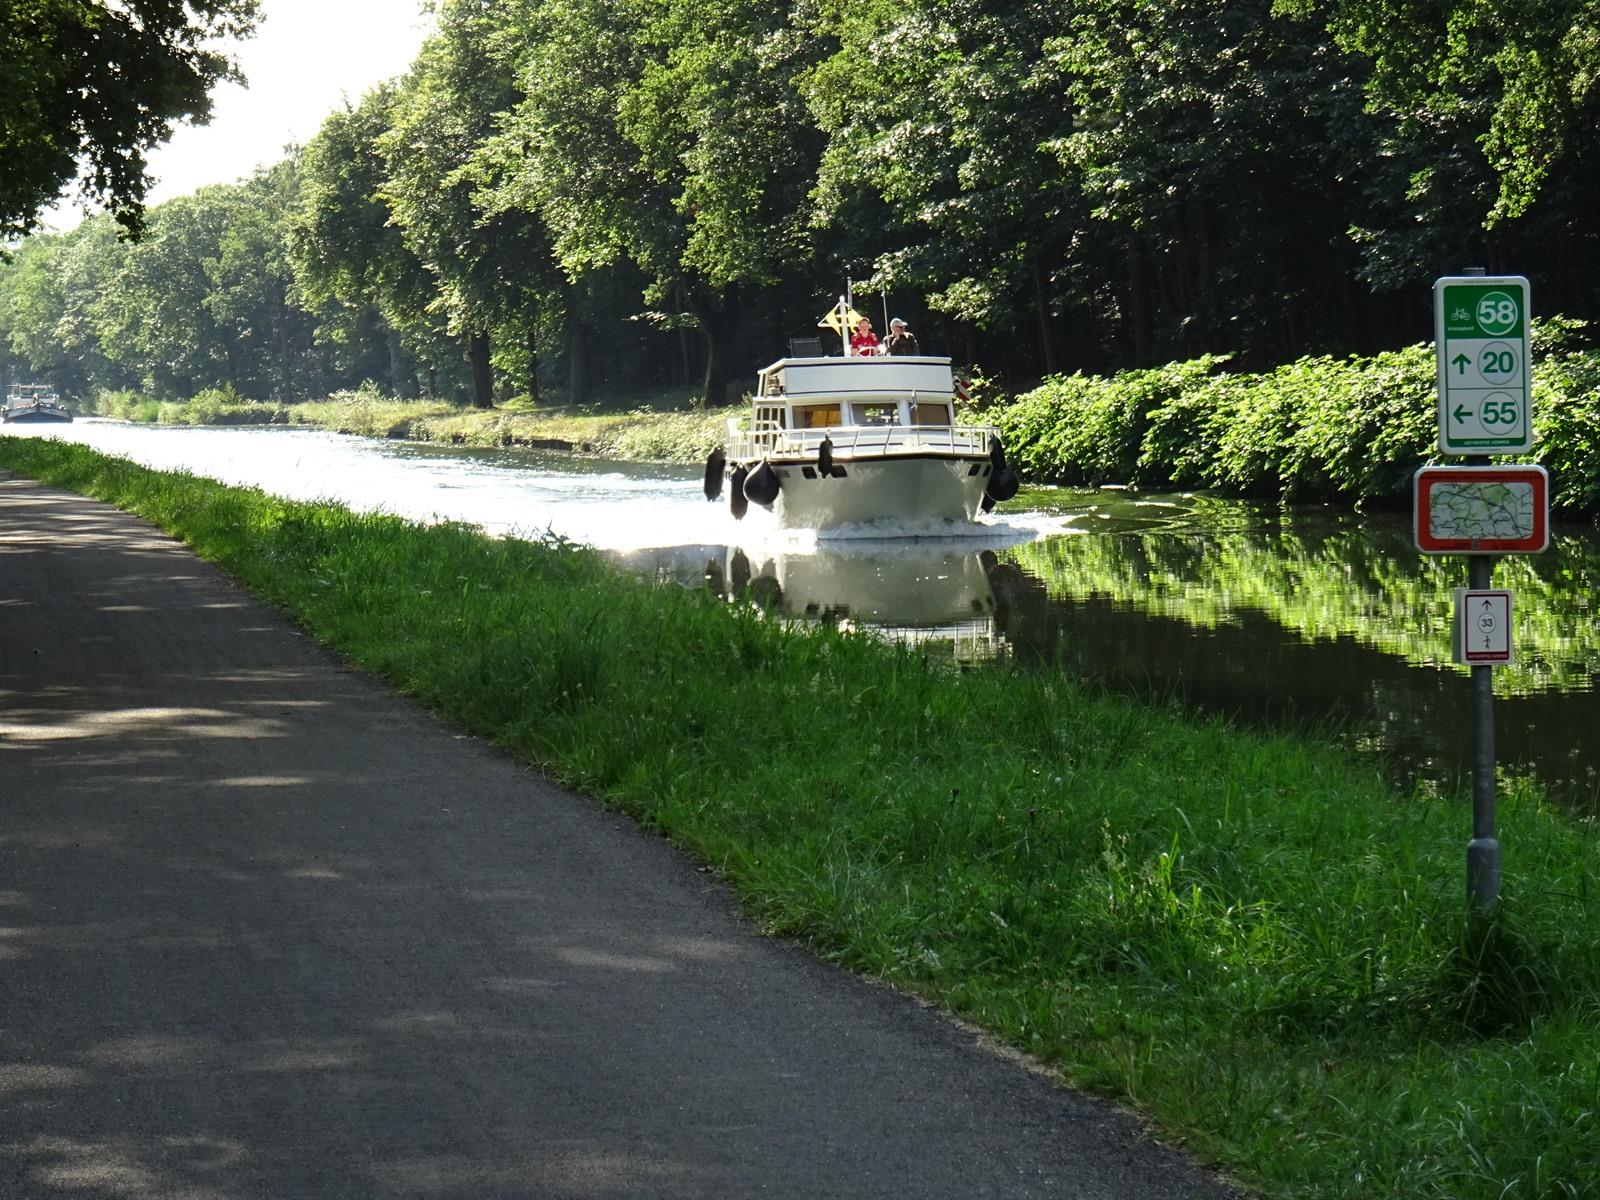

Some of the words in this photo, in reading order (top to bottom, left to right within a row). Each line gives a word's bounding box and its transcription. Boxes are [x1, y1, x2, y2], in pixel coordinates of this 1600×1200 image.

[1479, 301, 1514, 324] 58
[1482, 351, 1514, 373] 20
[1482, 402, 1517, 424] 55
[1481, 618, 1493, 627] 33
